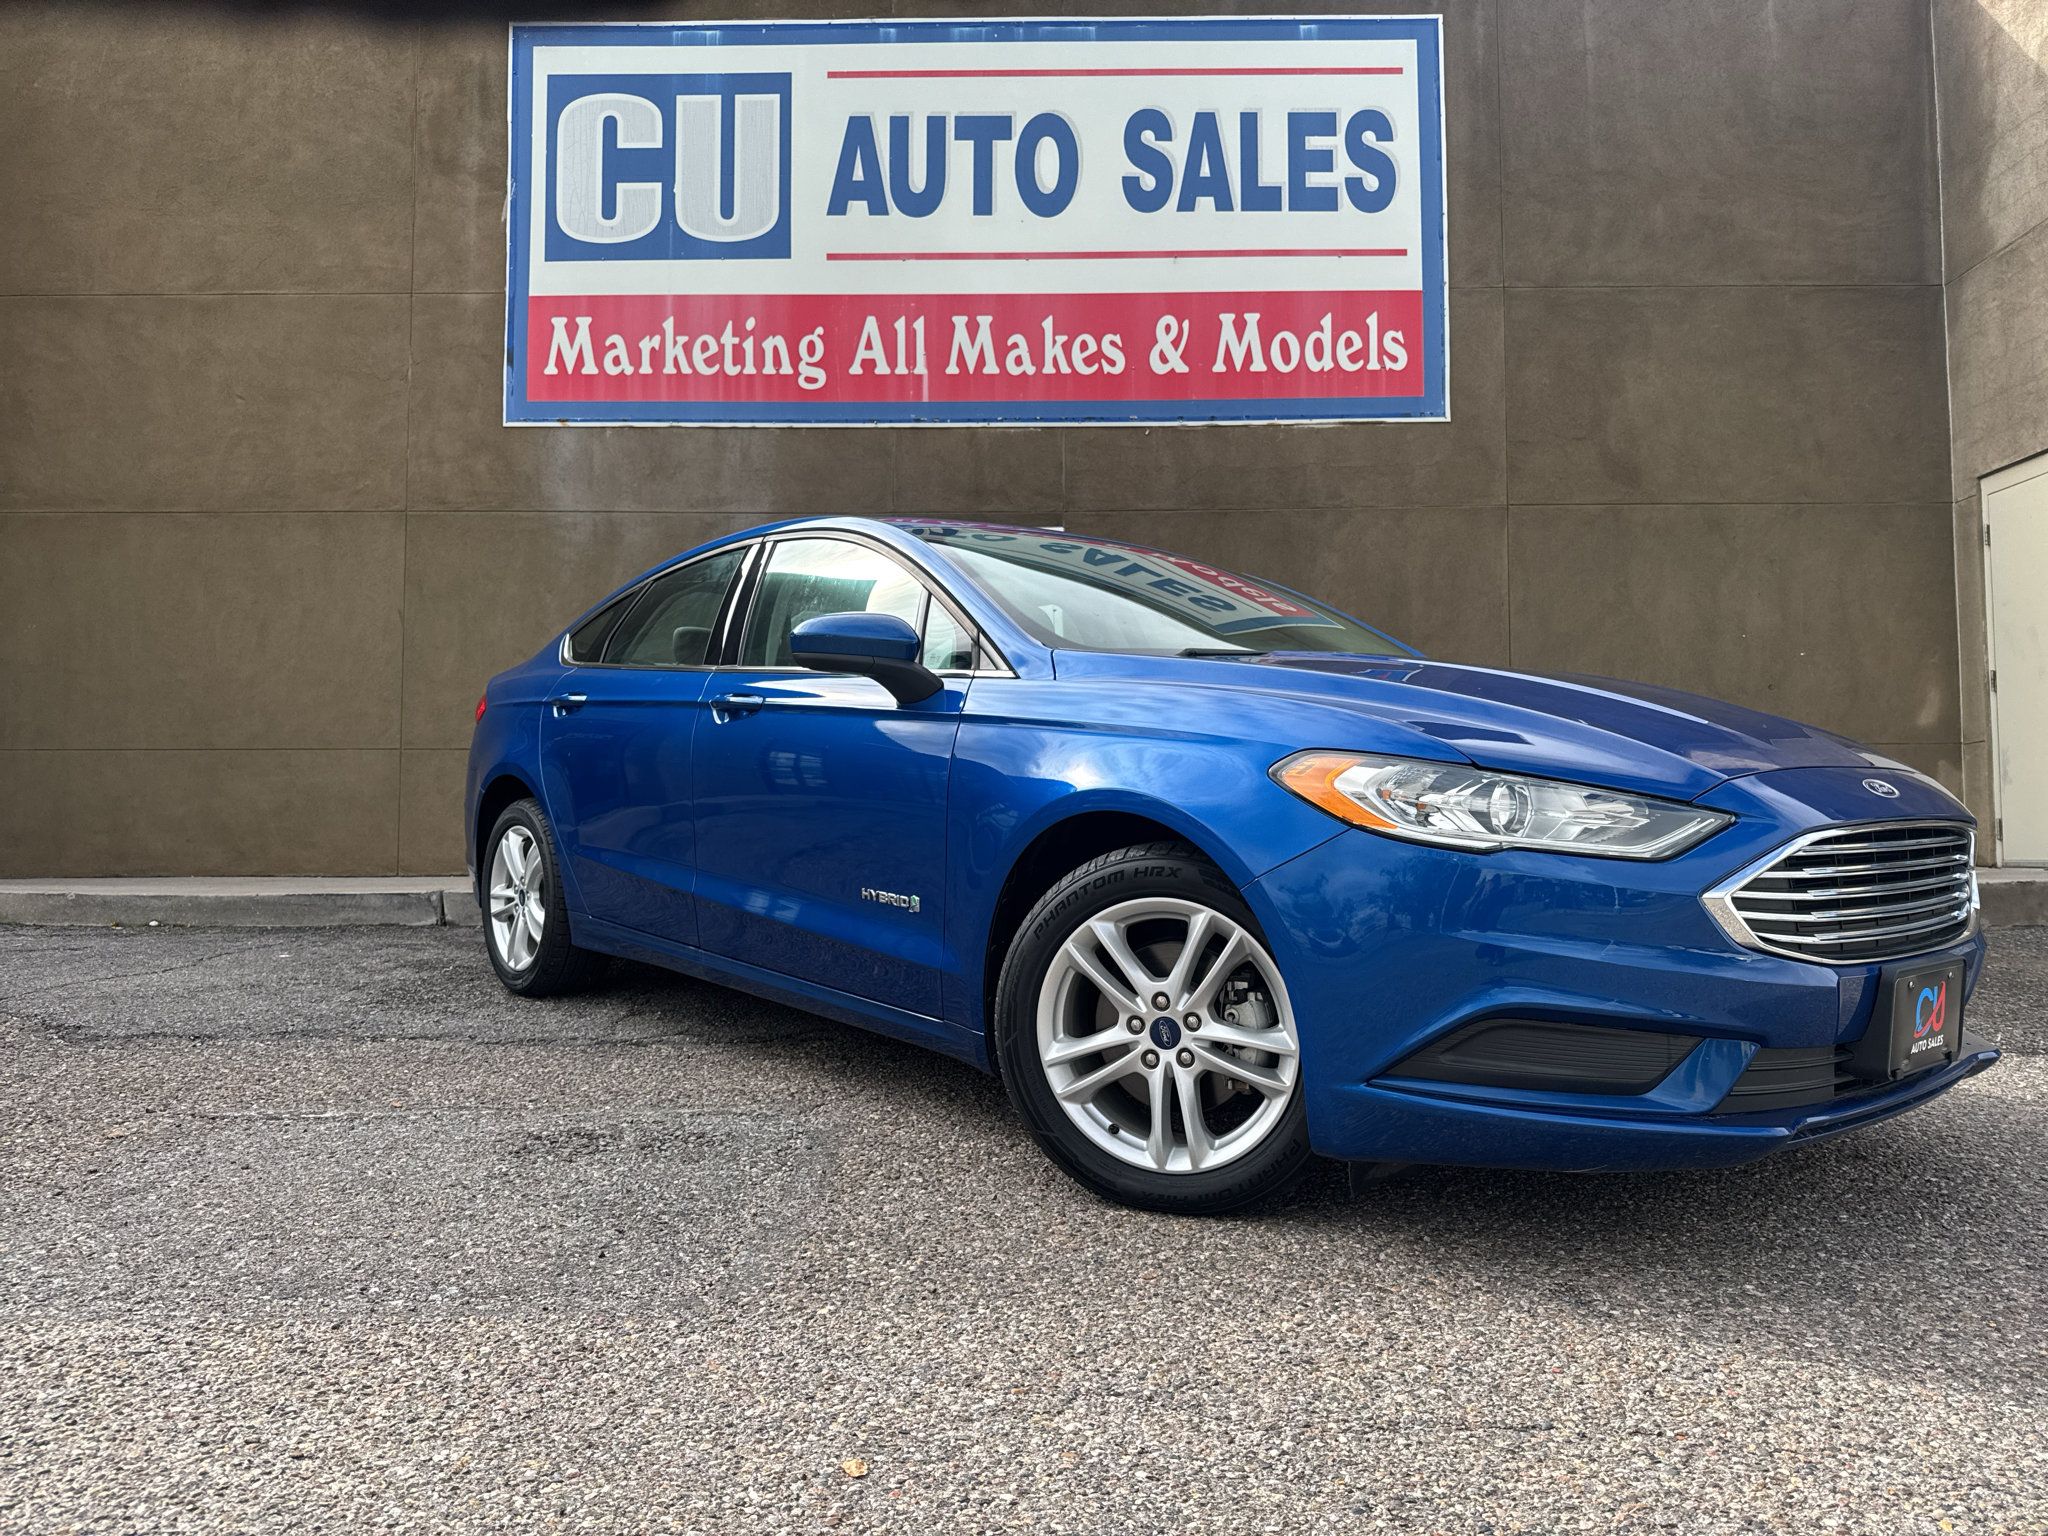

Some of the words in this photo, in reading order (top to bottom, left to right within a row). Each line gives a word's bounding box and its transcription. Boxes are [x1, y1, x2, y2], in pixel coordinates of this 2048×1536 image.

[556, 93, 781, 244] CU
[826, 111, 1082, 217] AUTO
[1122, 107, 1399, 214] SALES
[543, 314, 825, 390] Marketing
[849, 315, 927, 377] All
[950, 315, 1127, 378] Makes
[1150, 315, 1190, 375] &
[1213, 312, 1409, 373] Models
[861, 887, 909, 908] HYBRID
[1034, 868, 1126, 940] PHANTOM
[1133, 865, 1184, 880] HRX
[1911, 1039, 1927, 1054] AUTO
[1927, 1034, 1944, 1050] SALES
